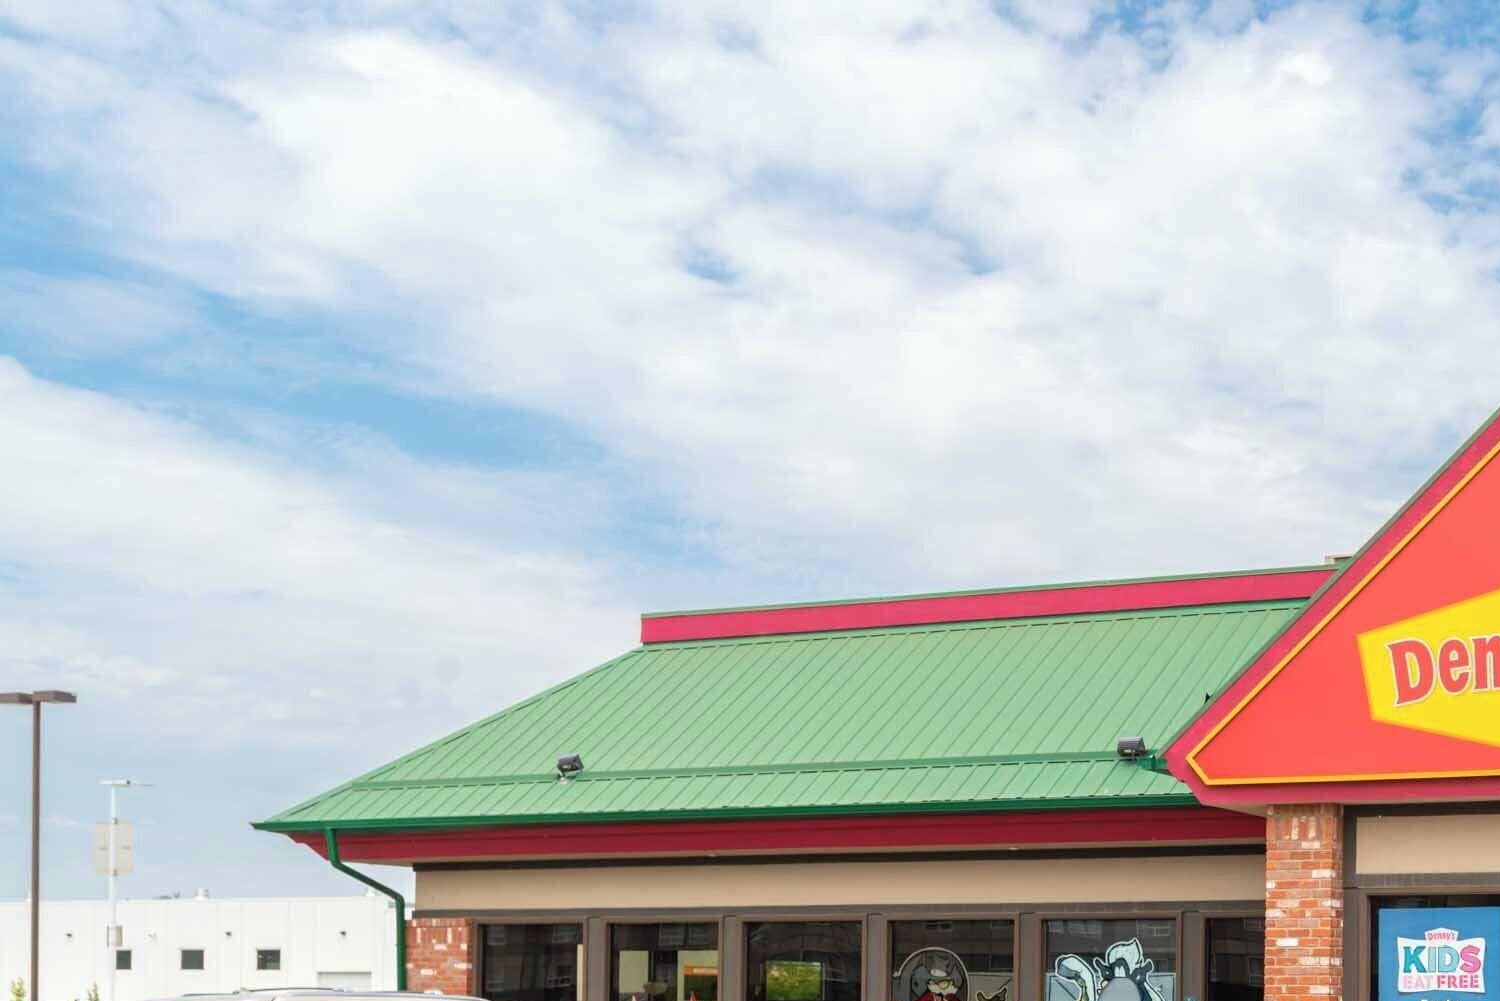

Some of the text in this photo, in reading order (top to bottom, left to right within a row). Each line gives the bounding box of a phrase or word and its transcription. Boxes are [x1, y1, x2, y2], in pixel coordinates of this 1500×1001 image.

[1403, 944, 1481, 974] KIDS
[1403, 974, 1480, 989] EAT FREE
